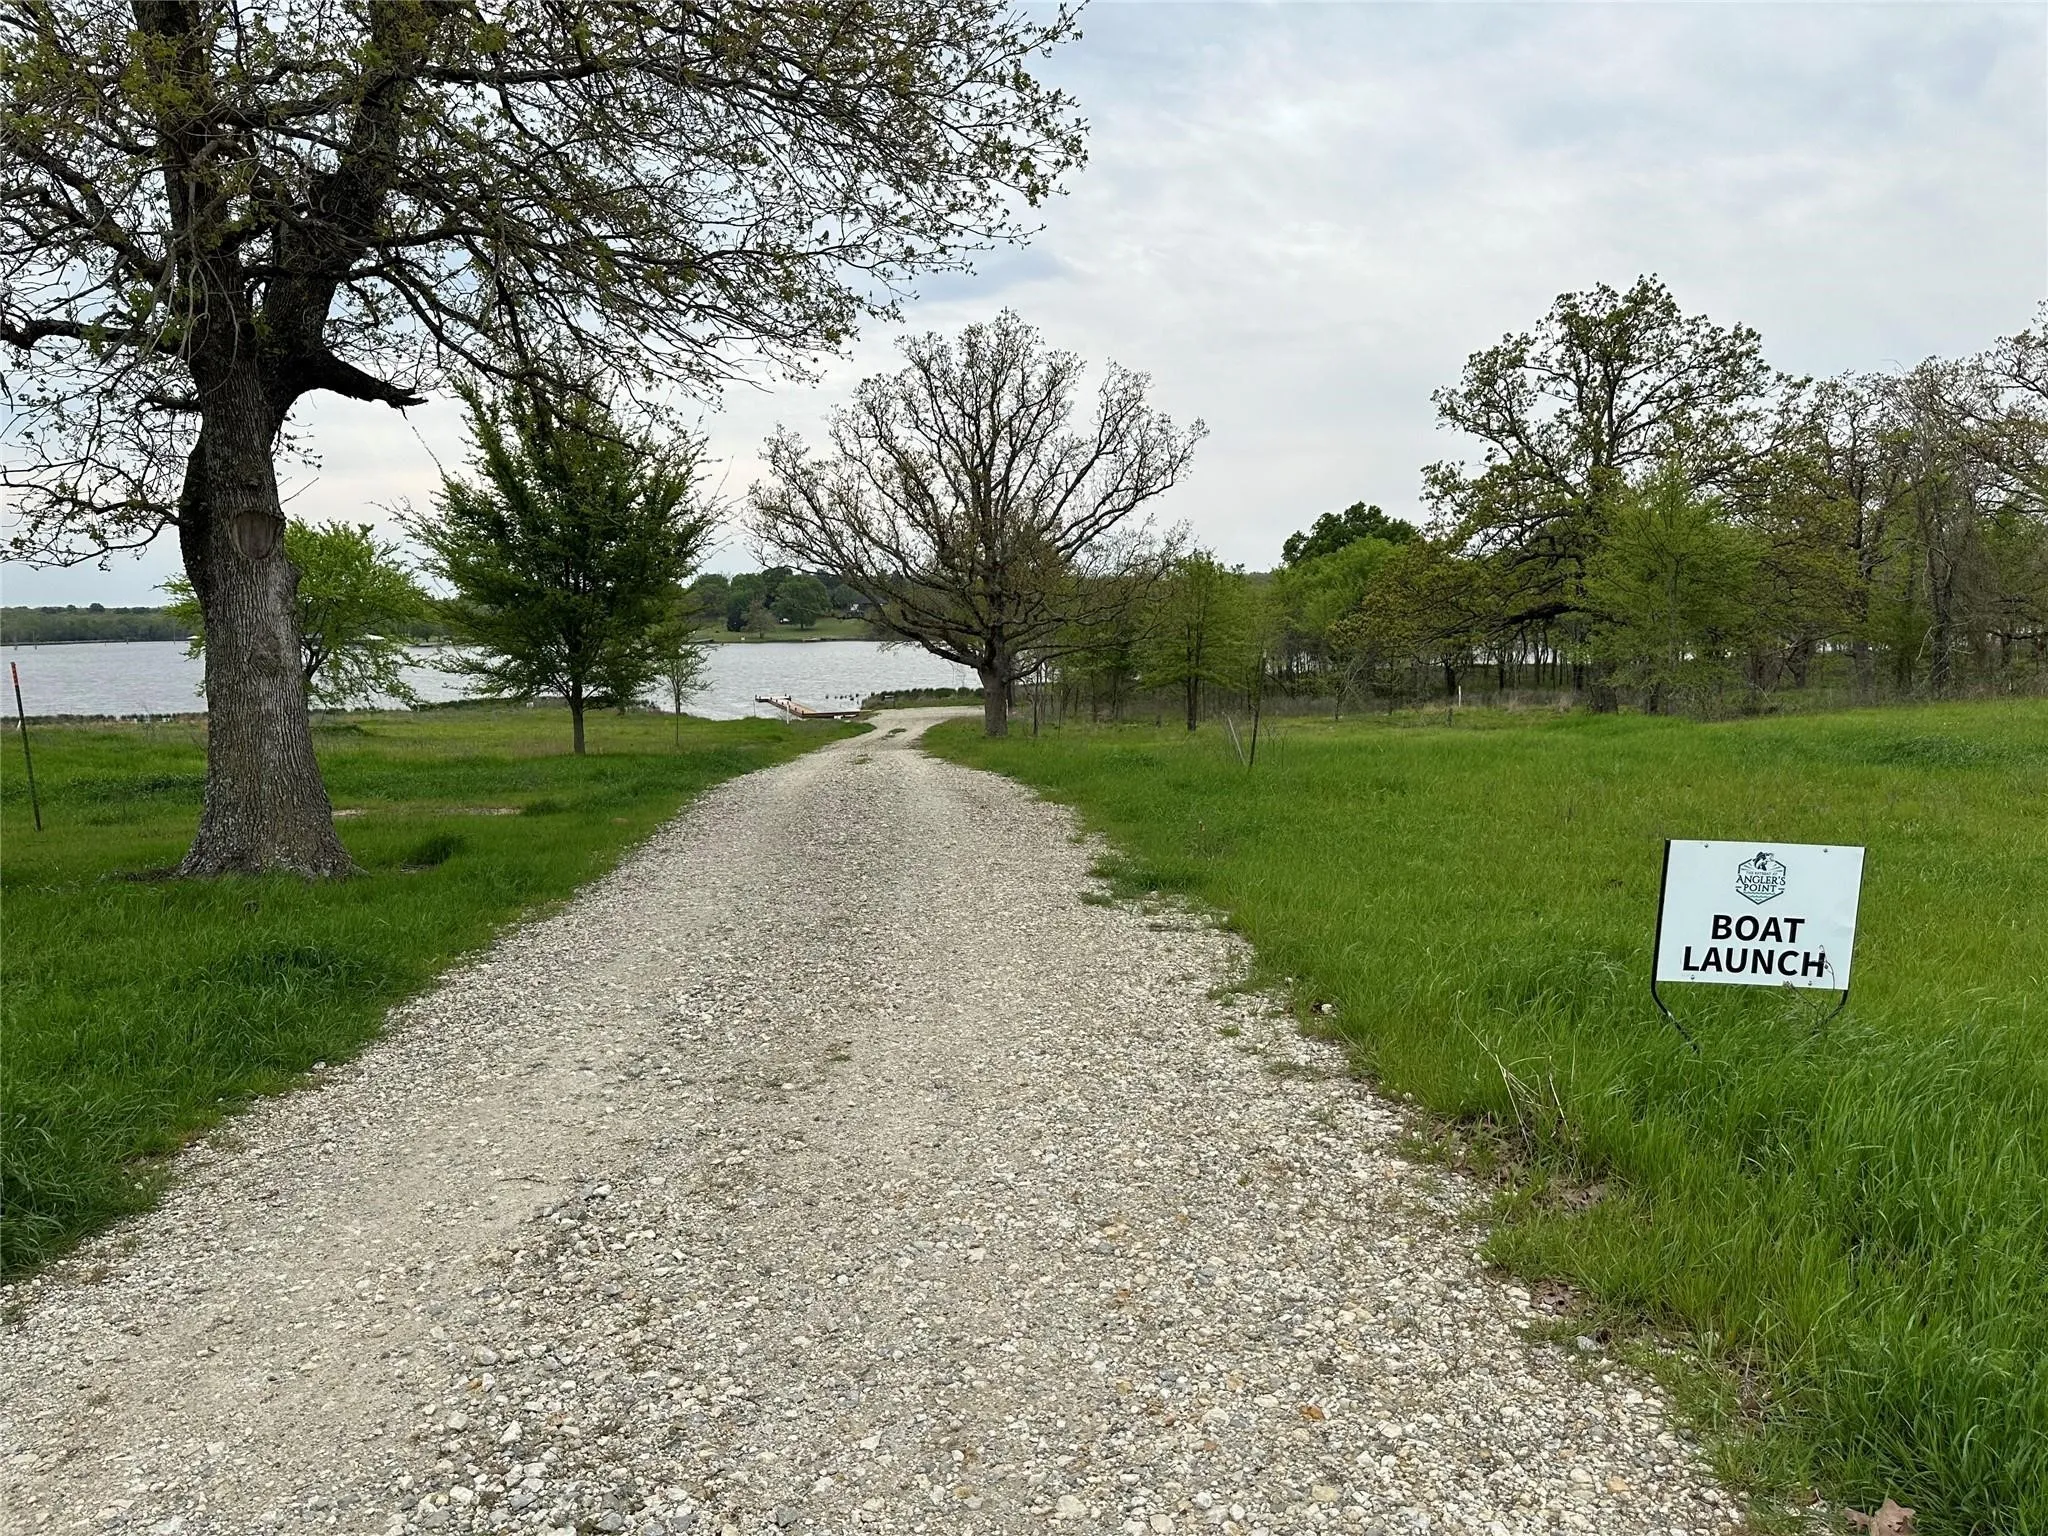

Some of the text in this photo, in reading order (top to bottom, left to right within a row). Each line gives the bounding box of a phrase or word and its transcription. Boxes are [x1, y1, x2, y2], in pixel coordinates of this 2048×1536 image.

[1736, 874, 1785, 885] ANGLER'S
[1743, 884, 1777, 892] POINT
[1711, 914, 1805, 943] BOAT
[1683, 946, 1825, 977] LAUNCH
